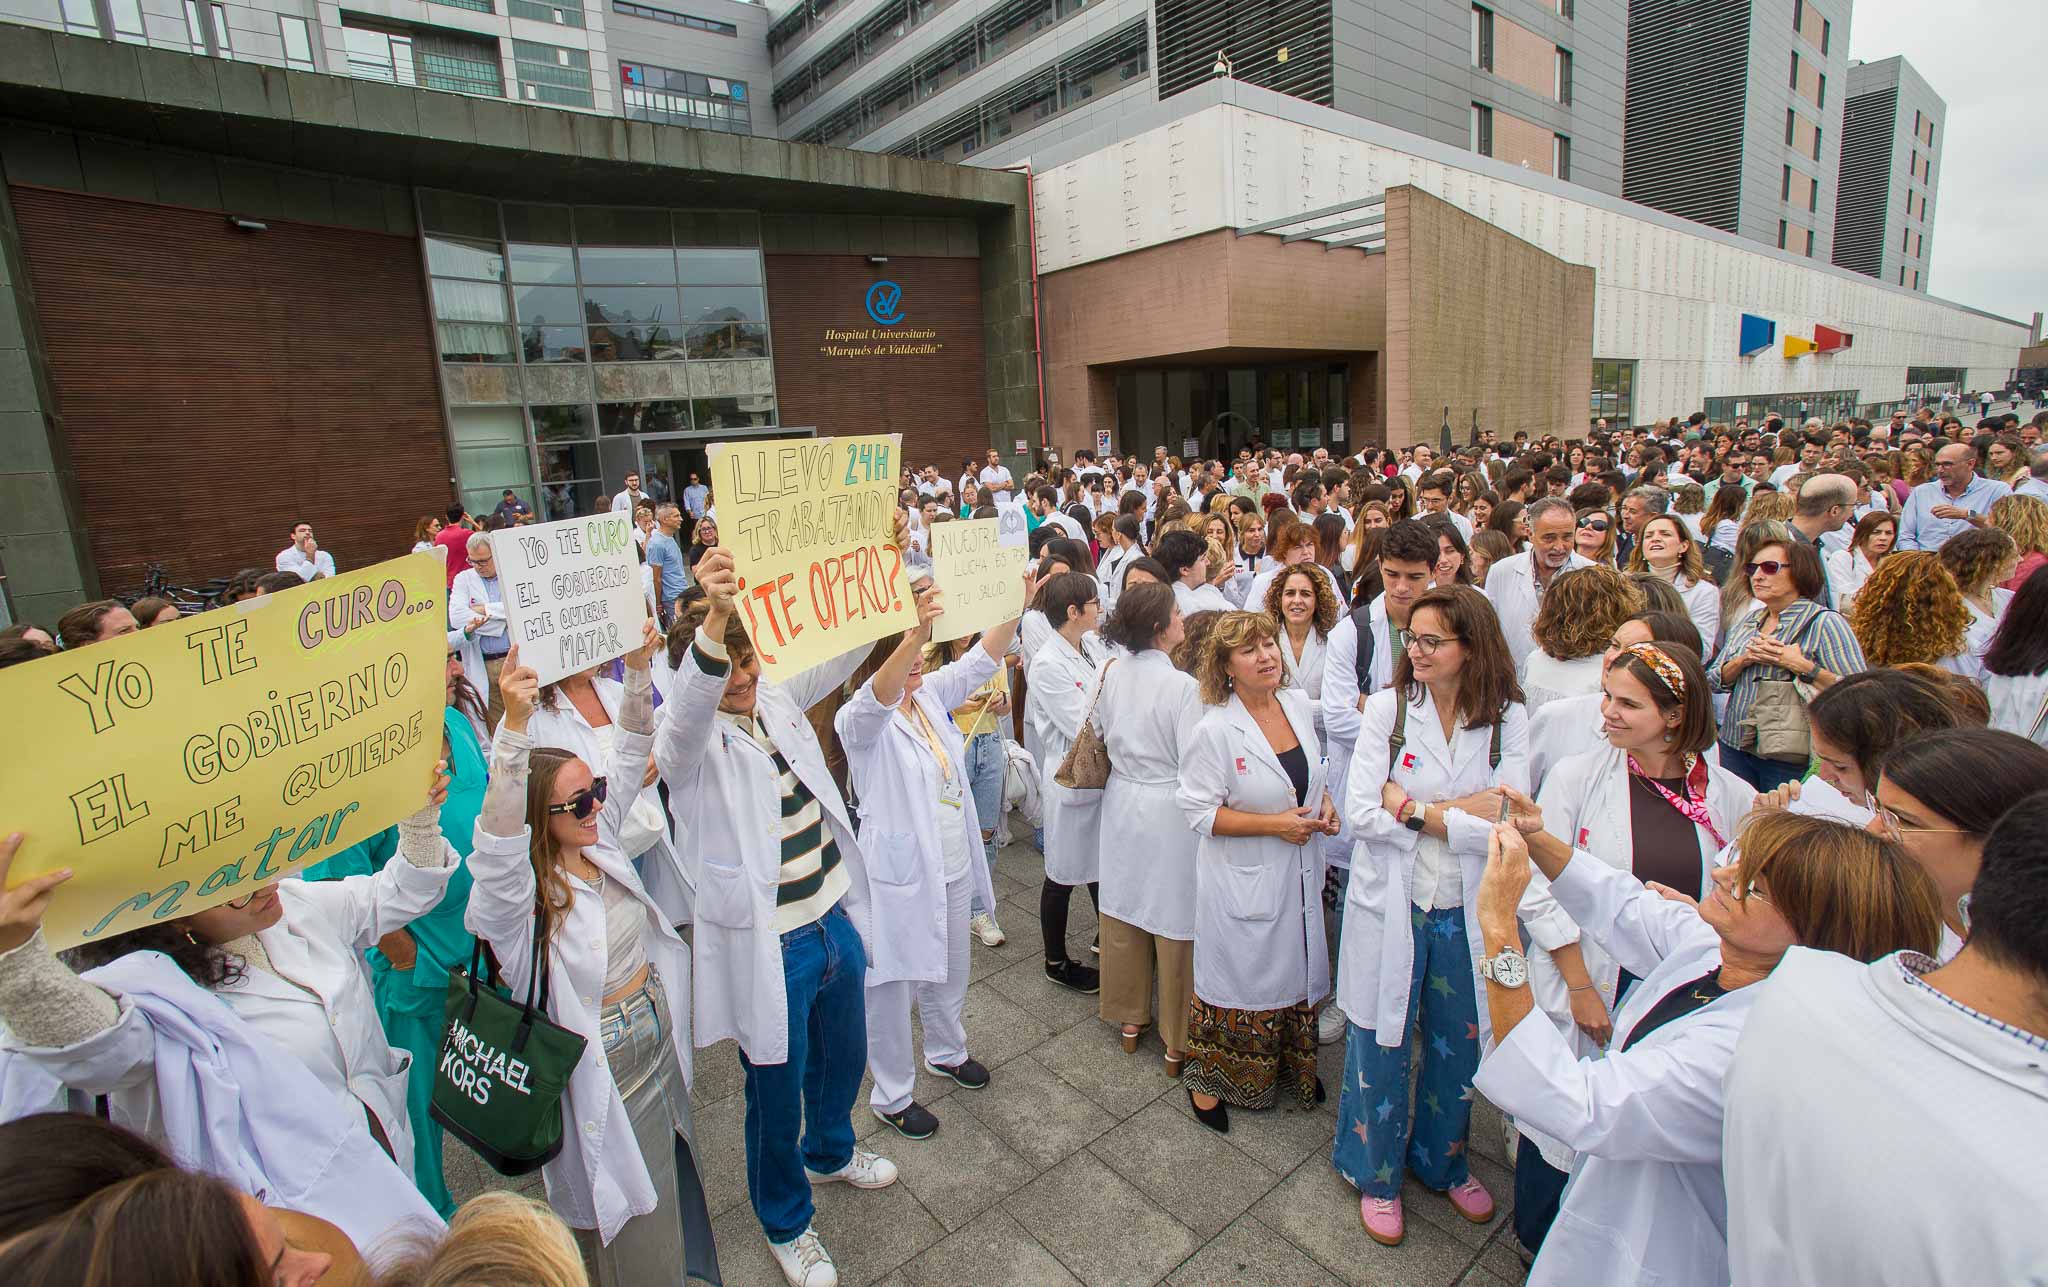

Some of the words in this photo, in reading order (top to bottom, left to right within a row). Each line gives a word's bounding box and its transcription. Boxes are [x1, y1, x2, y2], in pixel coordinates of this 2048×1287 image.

[825, 329, 869, 342] Hospital
[871, 328, 936, 340] Universitario
[874, 345, 886, 355] de
[731, 443, 834, 505] LLEVO
[843, 443, 889, 486] 24H
[519, 536, 549, 569] YO
[556, 527, 582, 555] TE
[587, 518, 630, 557] CURO
[738, 485, 897, 562] TRABAJANDO
[940, 527, 998, 560] NUESTRA
[516, 582, 540, 609] EL
[551, 564, 630, 600] GOBIERNO
[953, 559, 989, 577] LUCHA
[523, 611, 555, 642] ME
[559, 599, 609, 630] QUIERE
[737, 572, 804, 664] ¿TE
[808, 544, 903, 631] OPERO?
[956, 592, 971, 609] TU
[978, 581, 1006, 601] SALUD
[559, 622, 624, 669] MATAR
[58, 659, 153, 735] YO
[185, 618, 258, 686] TE
[69, 772, 150, 846] EL
[158, 795, 245, 869] ME
[282, 710, 423, 807] QUIERE
[440, 1047, 492, 1105] KORS
[443, 1018, 531, 1095] MICHAEL
